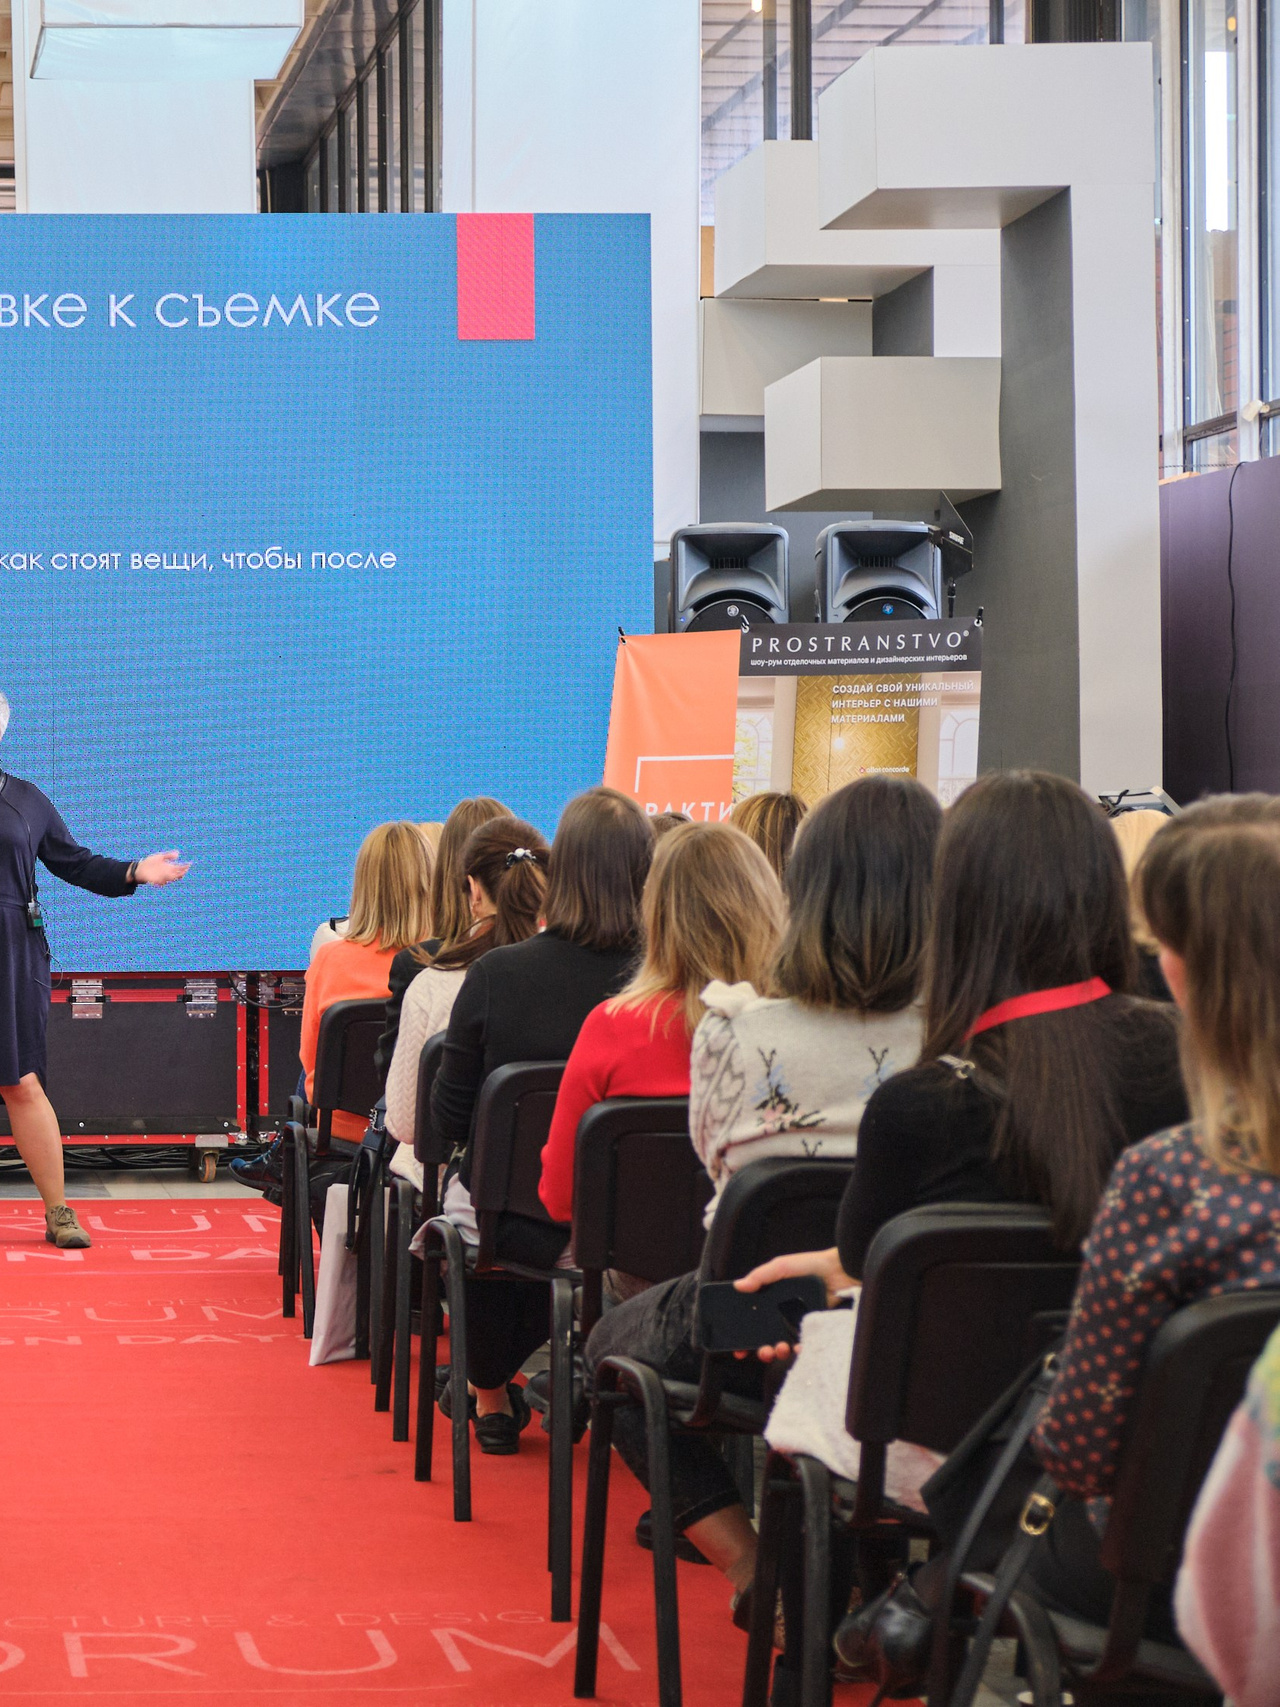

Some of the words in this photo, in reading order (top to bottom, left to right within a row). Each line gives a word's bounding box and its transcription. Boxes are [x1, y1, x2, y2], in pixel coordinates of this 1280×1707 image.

[109, 294, 136, 327] к
[155, 292, 380, 328] съемке
[51, 553, 121, 571] стоят
[131, 552, 214, 573] вещи,
[222, 545, 302, 570] чтобы
[311, 551, 397, 570] после
[749, 658, 783, 667] шоу-рум
[783, 657, 826, 667] отделочных
[827, 655, 870, 665] материалов
[870, 656, 876, 664] и
[876, 655, 926, 665] дизайнерских
[926, 653, 968, 663] интерьеров
[832, 682, 874, 695] СОЗДАЙ
[875, 681, 903, 694] СВОЙ
[905, 679, 975, 692] УНИКАЛЬНЫЙ
[831, 698, 881, 709] ИНТЕРЬЕР
[883, 698, 891, 708] С
[893, 696, 938, 707] НАШИМИ
[830, 713, 906, 724] МАТЕРИАЛАМИ
[644, 801, 734, 822] РАКТИ
[129, 1247, 280, 1262] DA
[116, 1333, 304, 1346] DAY
[333, 1609, 547, 1627] DESIG
